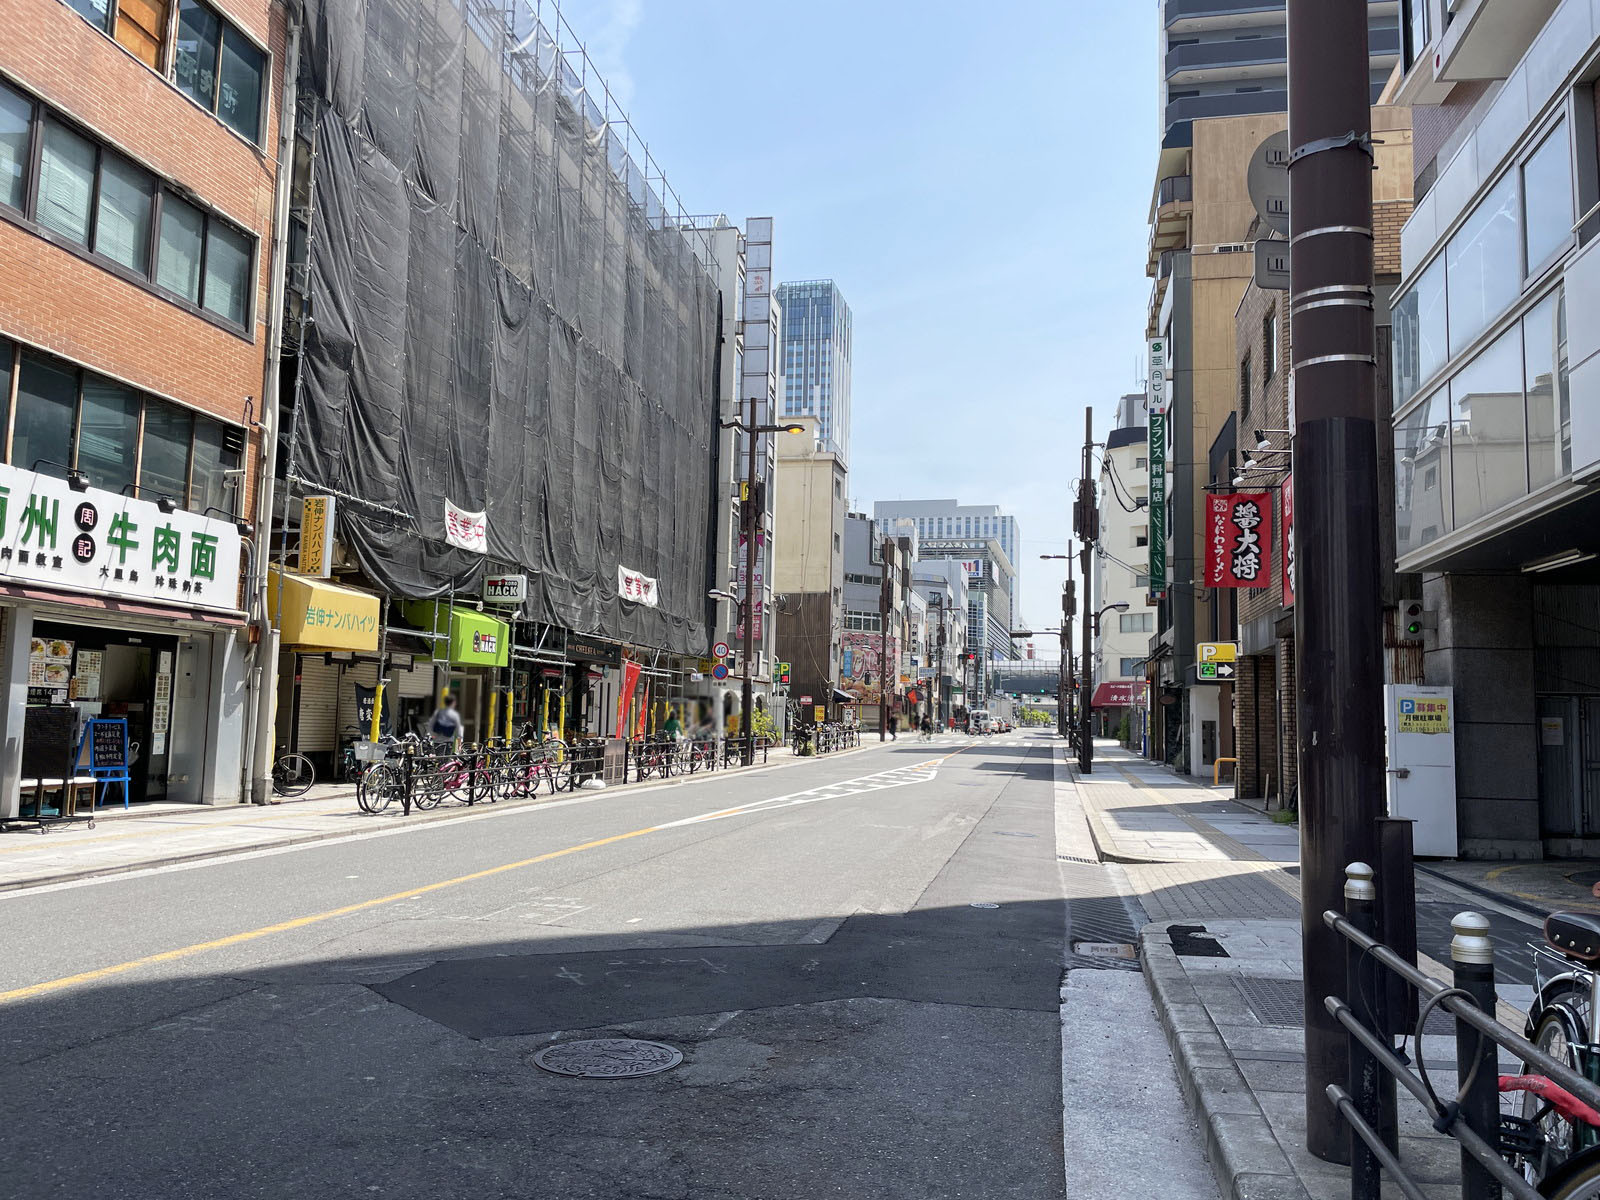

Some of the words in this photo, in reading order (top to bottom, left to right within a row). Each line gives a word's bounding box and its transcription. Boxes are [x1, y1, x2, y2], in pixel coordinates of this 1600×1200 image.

[1151, 416, 1164, 503] フランス料理店
[107, 511, 219, 581] 牛肉面
[312, 499, 324, 566] 岩伸ナンバハイツ
[1213, 514, 1226, 583] なにわラーメン
[487, 585, 517, 596] HACK
[306, 606, 375, 632] 岩伸ナンバハイツ
[716, 646, 726, 655] 40
[1416, 702, 1447, 713] 募集中
